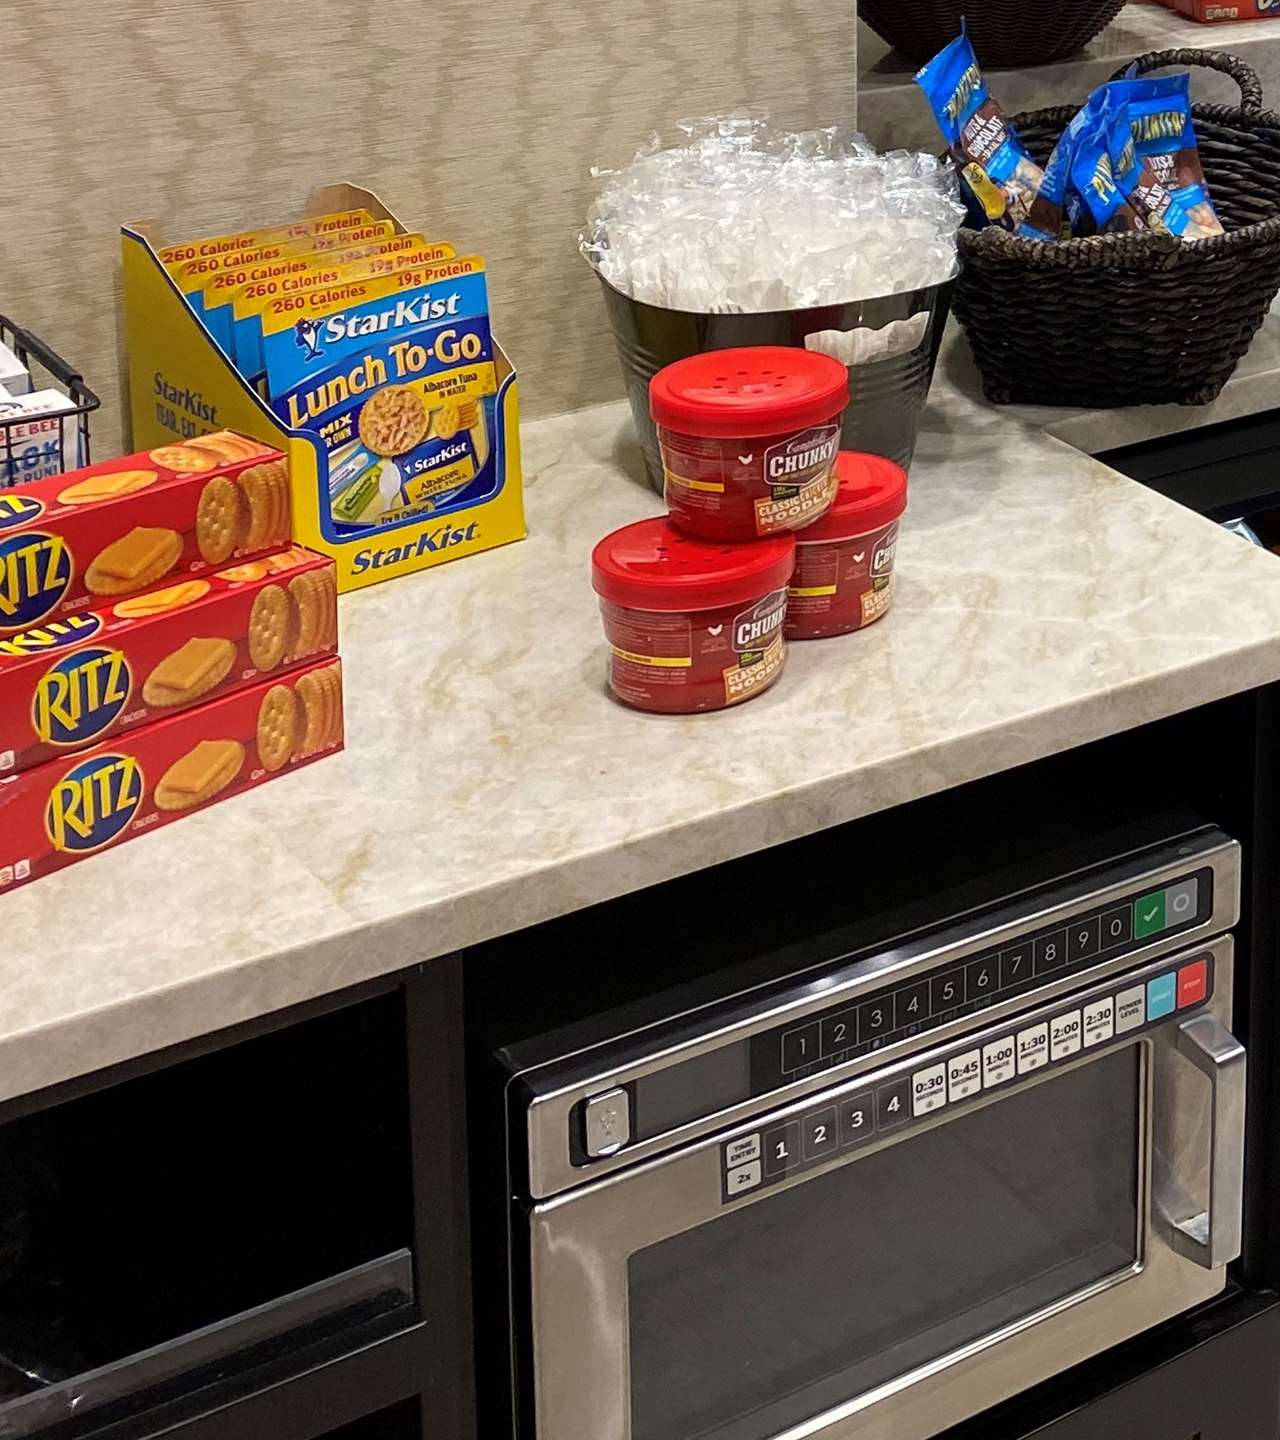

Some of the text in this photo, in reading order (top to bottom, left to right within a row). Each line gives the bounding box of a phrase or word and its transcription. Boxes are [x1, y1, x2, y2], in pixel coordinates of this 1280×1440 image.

[314, 215, 362, 235] Protein
[163, 236, 257, 263] 260 Calories
[187, 246, 280, 276] 260 Calories
[397, 247, 445, 267] Protein
[214, 260, 308, 289] 260 Calories
[245, 269, 339, 300] 260 Calories
[398, 260, 473, 288] 19g Protein
[272, 284, 367, 315] 260 Calories
[324, 291, 462, 342] StarKist
[287, 355, 389, 429] Lunch
[423, 372, 478, 394] Albacore Tuna
[154, 372, 218, 426] StarKist
[319, 413, 352, 438] MIX
[414, 441, 467, 473] StarKist
[769, 438, 835, 478] CHUNKY
[758, 493, 800, 517] CLASSIC
[351, 521, 479, 575] StarKist
[38, 650, 125, 743] RITZ
[51, 756, 138, 852] RITZ
[799, 1038, 807, 1056] 1
[833, 1024, 847, 1042] 2
[870, 1010, 883, 1028] 3
[907, 996, 919, 1013] 4
[942, 981, 955, 1001] 5
[977, 969, 989, 987] 6
[1010, 955, 1023, 975] 7
[1044, 943, 1057, 961] 8
[1078, 931, 1089, 949] 9
[1118, 998, 1143, 1013] POWER
[1085, 1007, 1112, 1026] 2:30
[1120, 1006, 1140, 1020] LEVEL
[1019, 1033, 1047, 1053] 1:30
[1052, 1020, 1079, 1040] 2:00
[985, 1047, 1013, 1067] 1:00
[950, 1060, 979, 1081] 0:45
[915, 1074, 945, 1095] 0:30
[775, 1095, 901, 1160] 1 2 3 4
[730, 1147, 757, 1163] ENTRY
[732, 1139, 753, 1152] TIME
[737, 1172, 752, 1185] 2x
